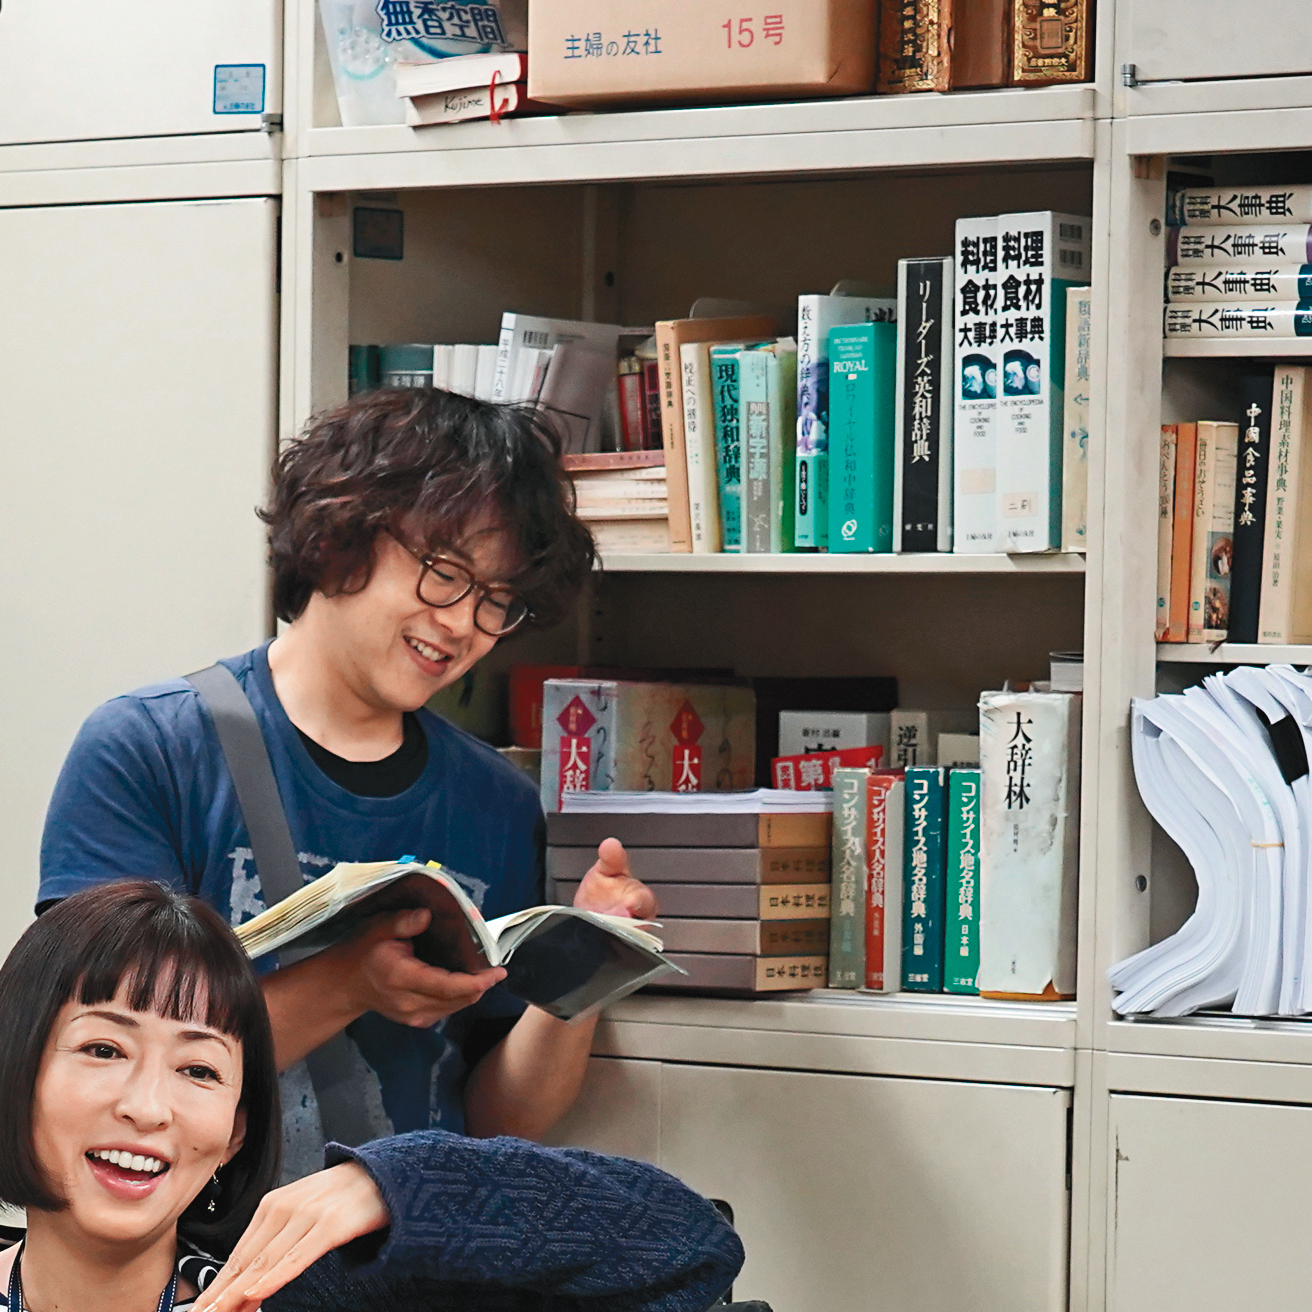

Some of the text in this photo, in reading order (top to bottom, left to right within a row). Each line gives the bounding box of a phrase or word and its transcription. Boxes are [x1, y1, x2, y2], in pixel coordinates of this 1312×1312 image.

[381, 0, 505, 42] 無香空間
[564, 15, 785, 59] 主婦の友社 15号
[1211, 193, 1294, 217] 大事典
[960, 235, 997, 274] 料理
[1001, 231, 1044, 270] 料理
[1205, 233, 1287, 257] 大事典
[960, 279, 997, 317] 食材
[1001, 273, 1044, 312] 食材
[1196, 269, 1279, 294] 大事典
[958, 321, 997, 347] 大事典
[999, 316, 1044, 343] 大事典
[1192, 307, 1276, 331] 大事典
[833, 361, 868, 373] ROYAL
[911, 280, 935, 464] リーダーズ英和辞典
[718, 363, 740, 484] 現代独和辞典
[1011, 413, 1032, 421] COOKING
[1015, 426, 1028, 435] FOOD
[1274, 374, 1294, 492] 中国料理素材事典
[897, 725, 919, 767] 逆引
[1004, 711, 1034, 811] 大辞林
[675, 749, 699, 792] 大
[840, 779, 859, 917] コンサイス人名辞典
[871, 786, 885, 908] コンサイス人名辞典
[911, 779, 929, 956] コンサイス地名辞典 外国編
[958, 781, 976, 957] コンサイス地名辞典 日本編
[908, 973, 929, 982] 三省堂
[953, 977, 973, 986] 三省堂
